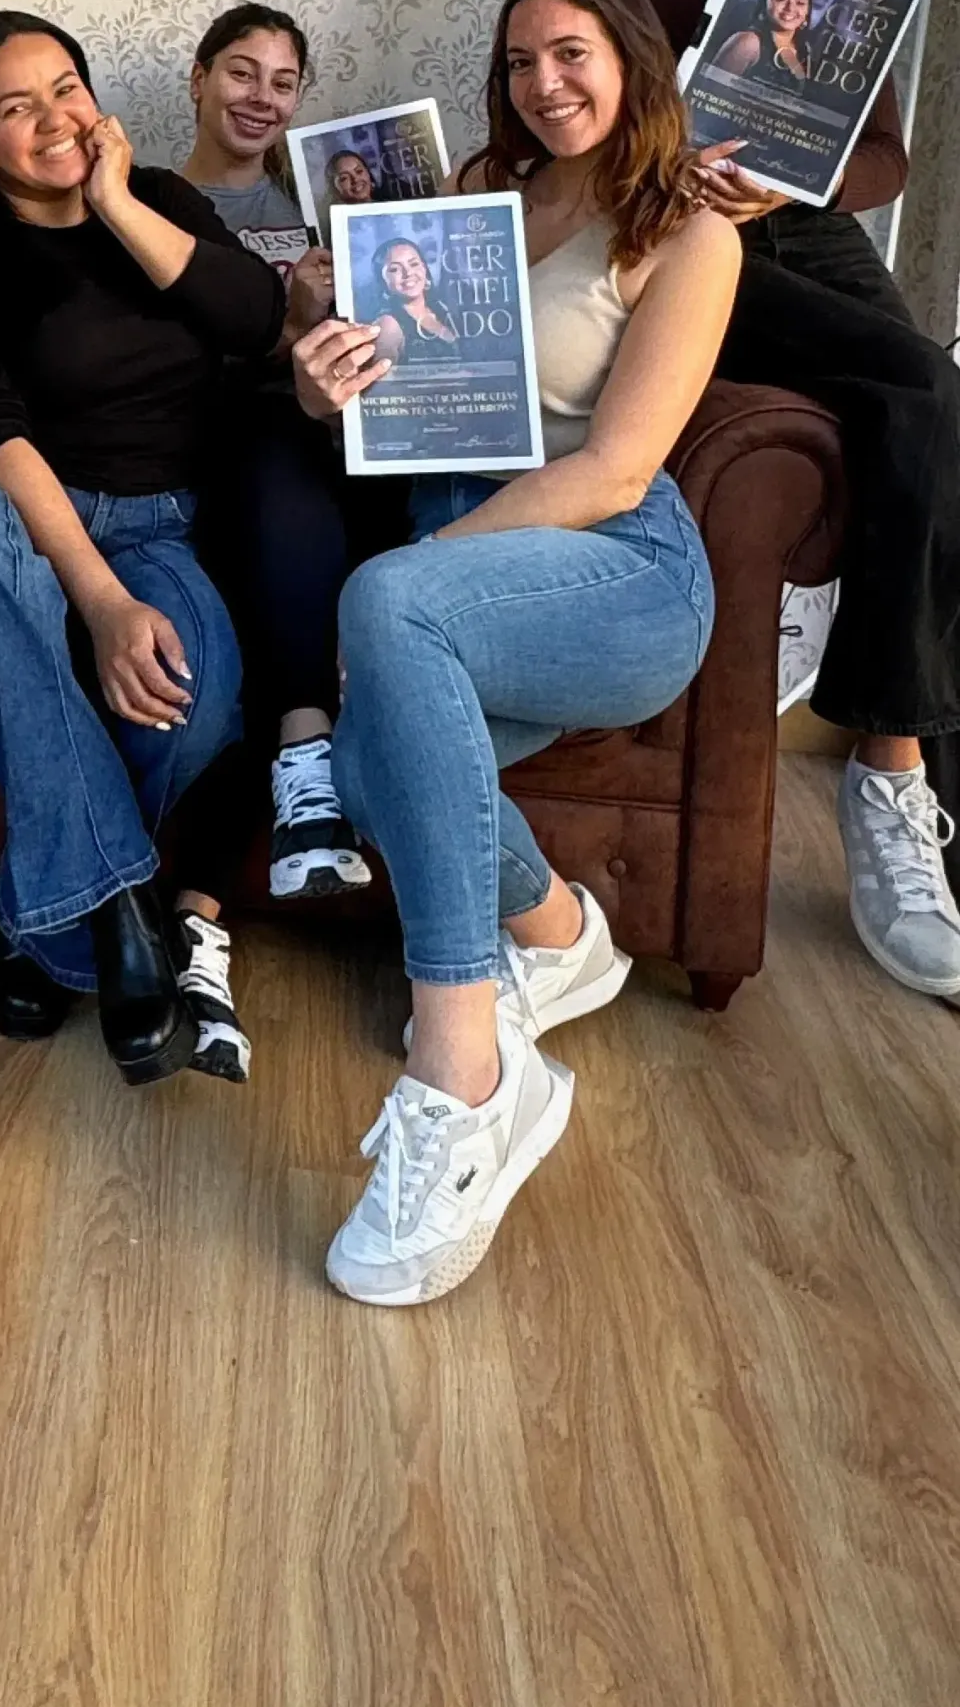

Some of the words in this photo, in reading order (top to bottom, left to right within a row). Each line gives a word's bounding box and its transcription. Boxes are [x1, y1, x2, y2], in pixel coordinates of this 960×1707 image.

[826, 3, 889, 43] CER
[821, 29, 880, 70] TIFI
[243, 233, 307, 252] UESS
[442, 244, 507, 273] CER
[448, 276, 510, 306] TIFI
